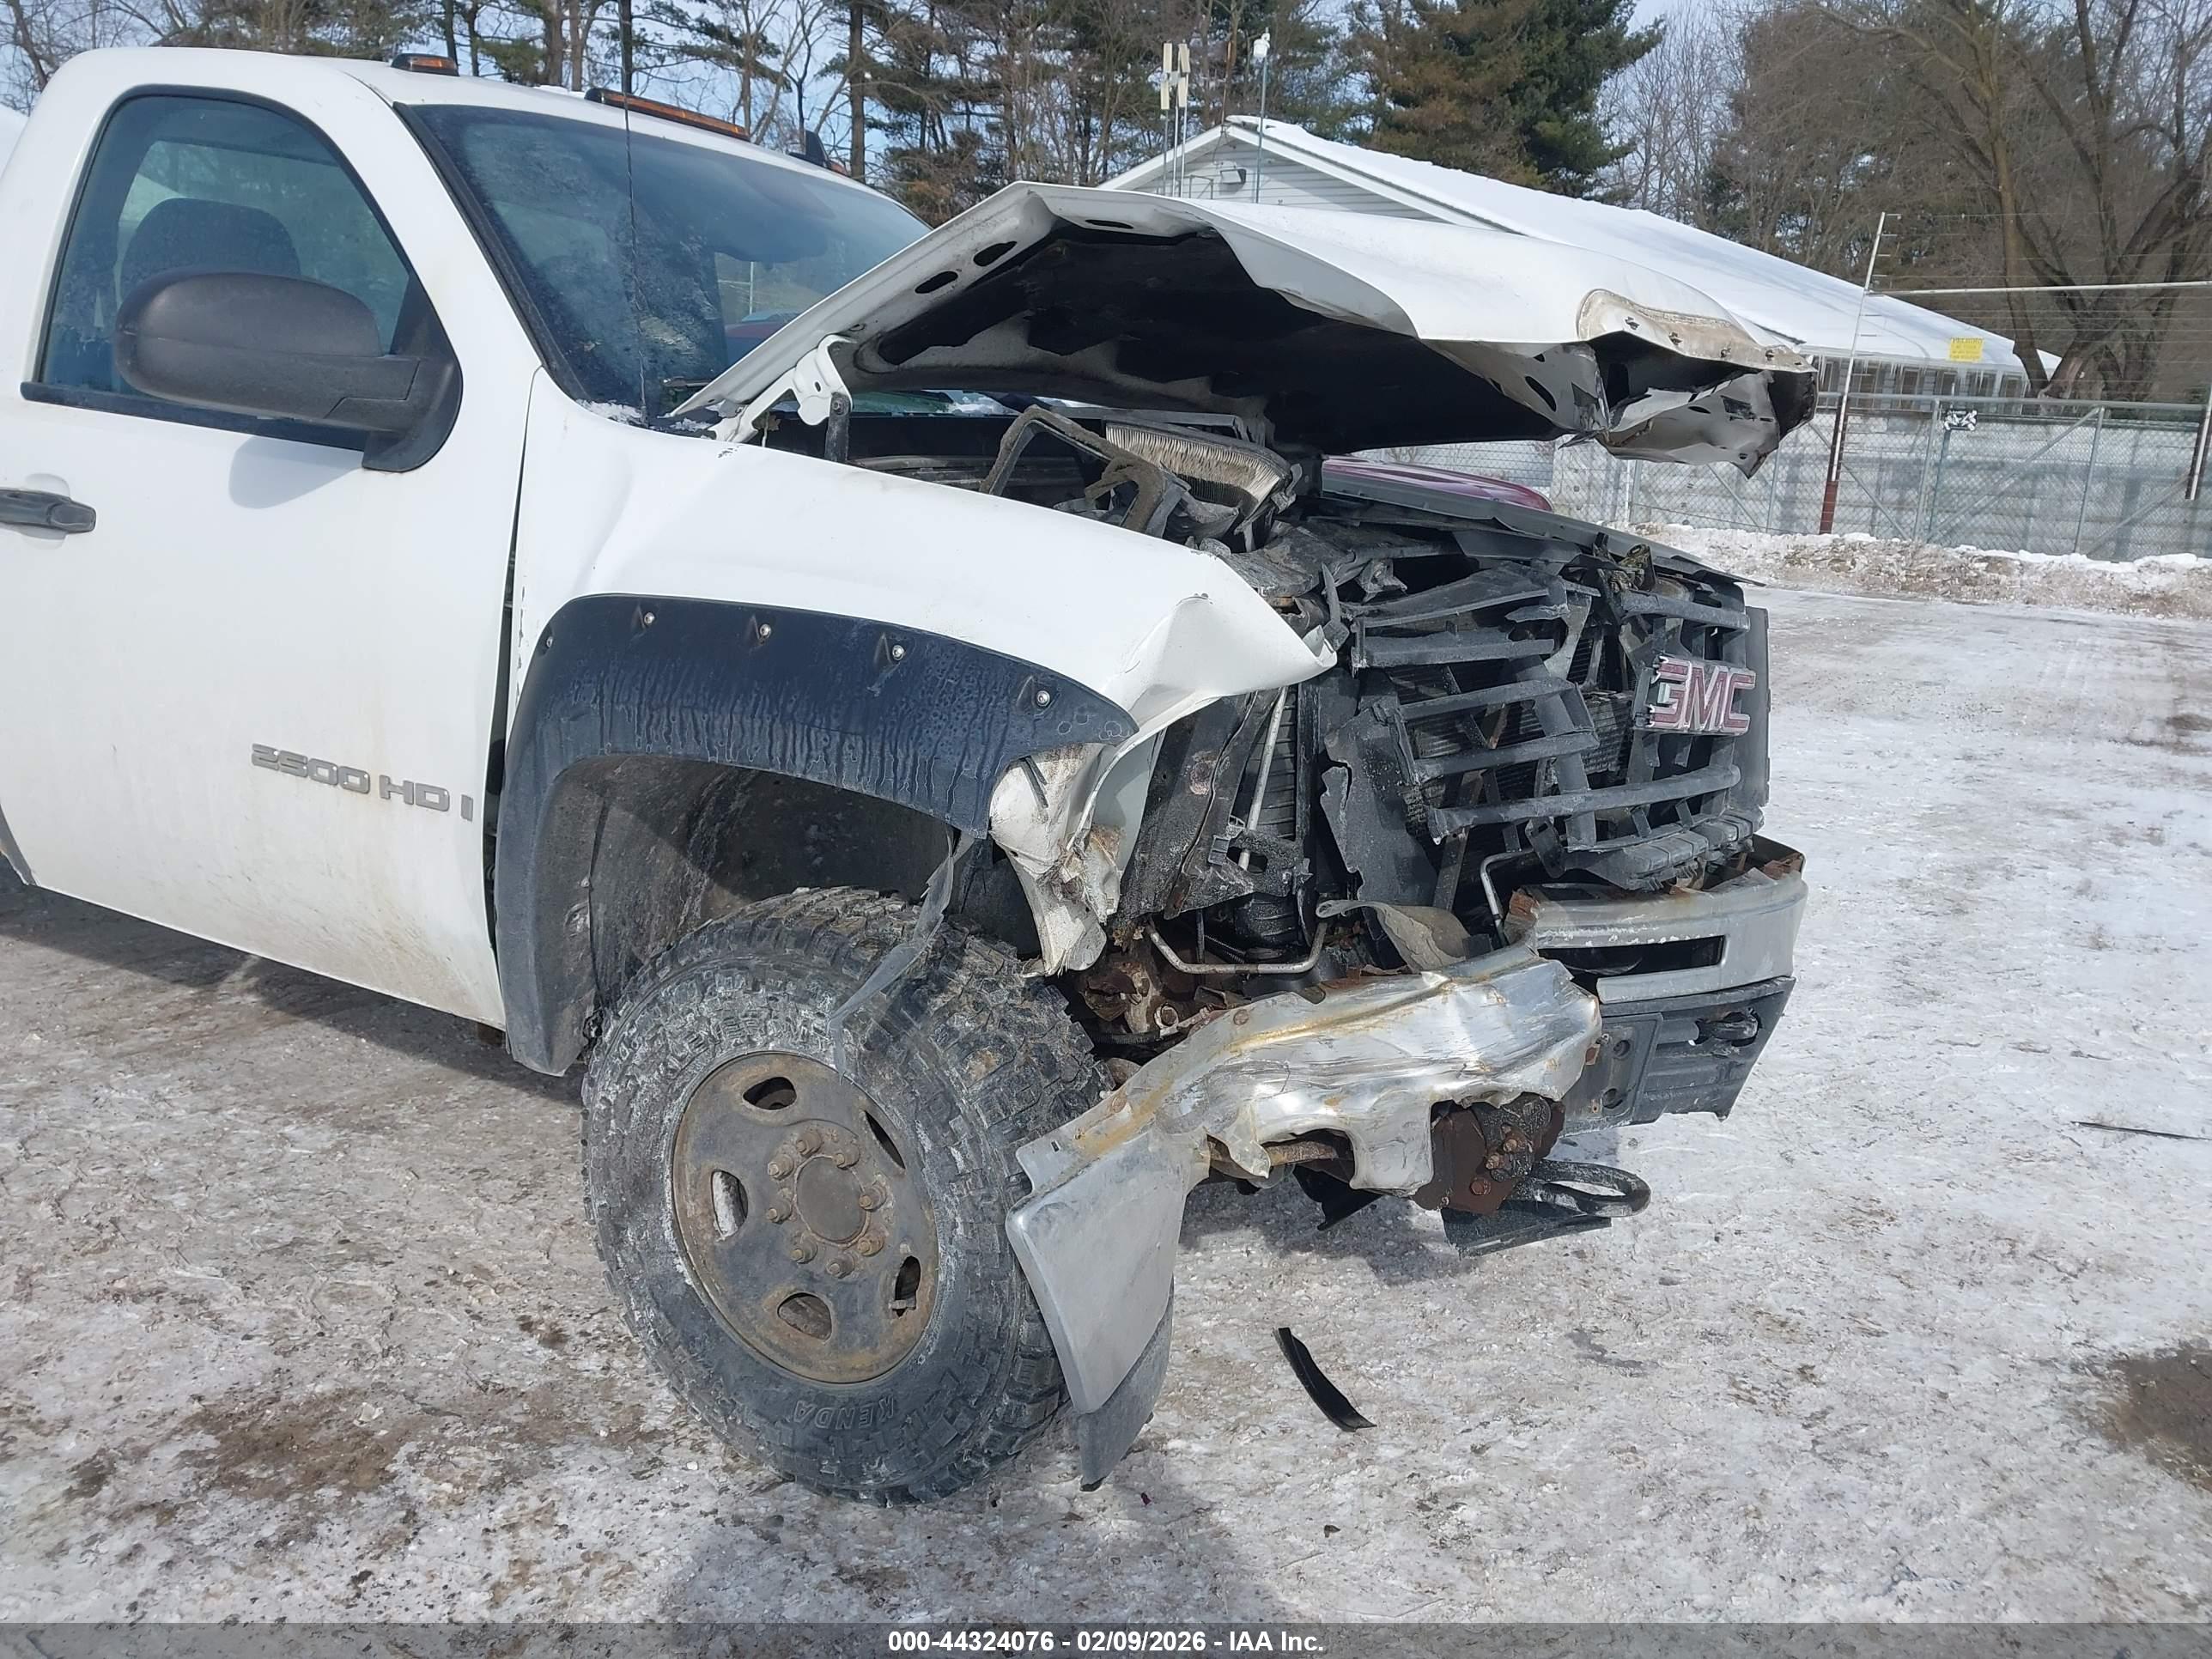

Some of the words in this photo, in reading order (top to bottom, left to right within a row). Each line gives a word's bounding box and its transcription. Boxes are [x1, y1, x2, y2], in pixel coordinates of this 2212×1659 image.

[1636, 655, 1756, 735] GMC
[252, 743, 371, 794] 2500
[379, 775, 451, 812] HD
[793, 1395, 895, 1430] KENDA
